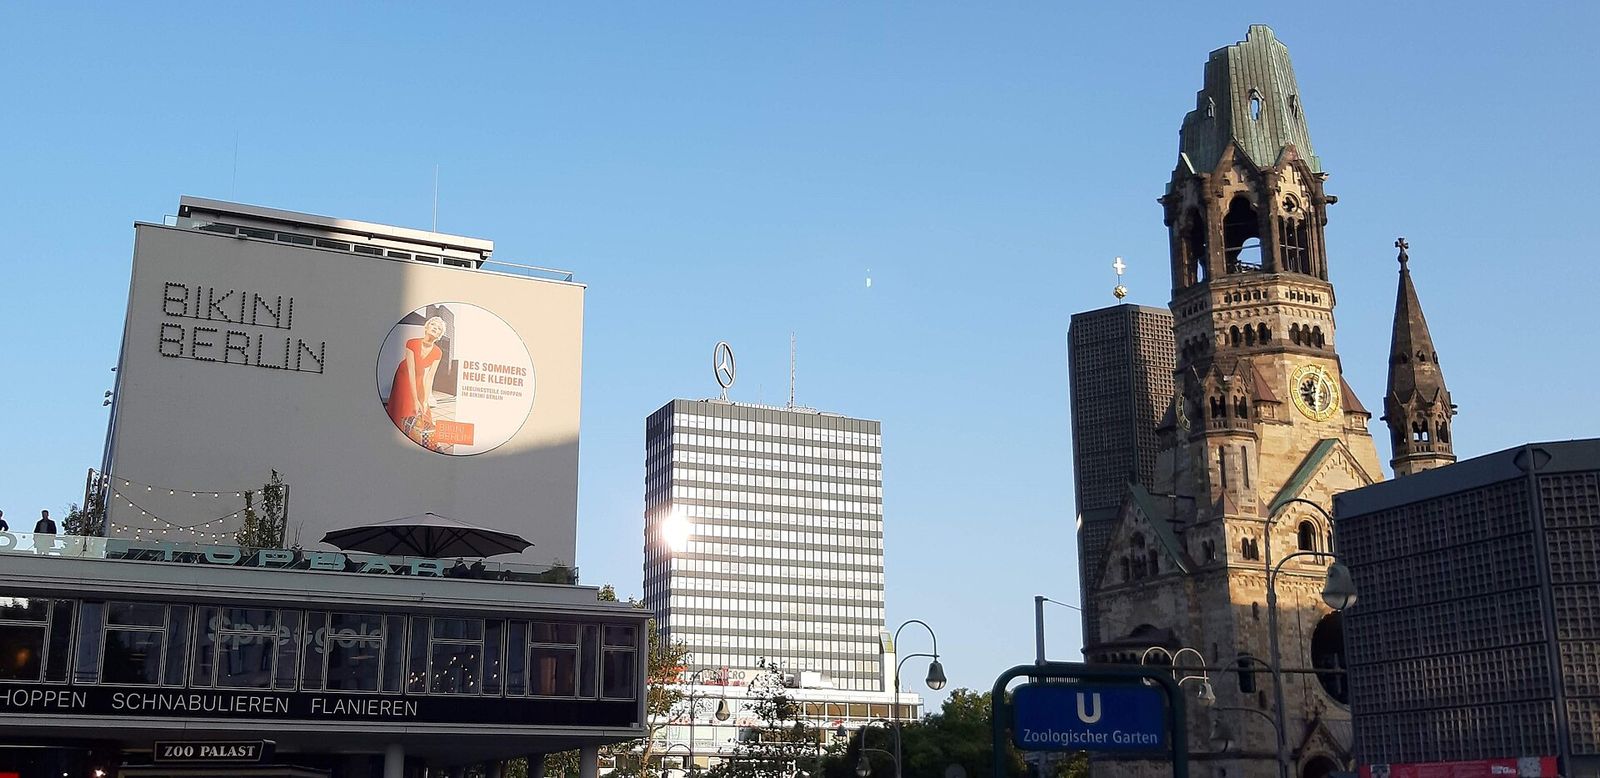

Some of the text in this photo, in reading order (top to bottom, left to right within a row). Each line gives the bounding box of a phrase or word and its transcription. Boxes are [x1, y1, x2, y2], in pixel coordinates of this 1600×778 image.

[163, 281, 294, 330] BIKINI
[159, 322, 326, 374] BERLIN
[462, 371, 524, 387] NEUE KLEIDER
[463, 360, 527, 377] DES SOMMERS
[112, 692, 289, 713] SCHNABULIEREN
[311, 698, 418, 716] FLANIEREN
[1076, 692, 1102, 724] U
[1023, 728, 1158, 746] Zoologischer Garten
[164, 745, 256, 758] ZOO PALAST
